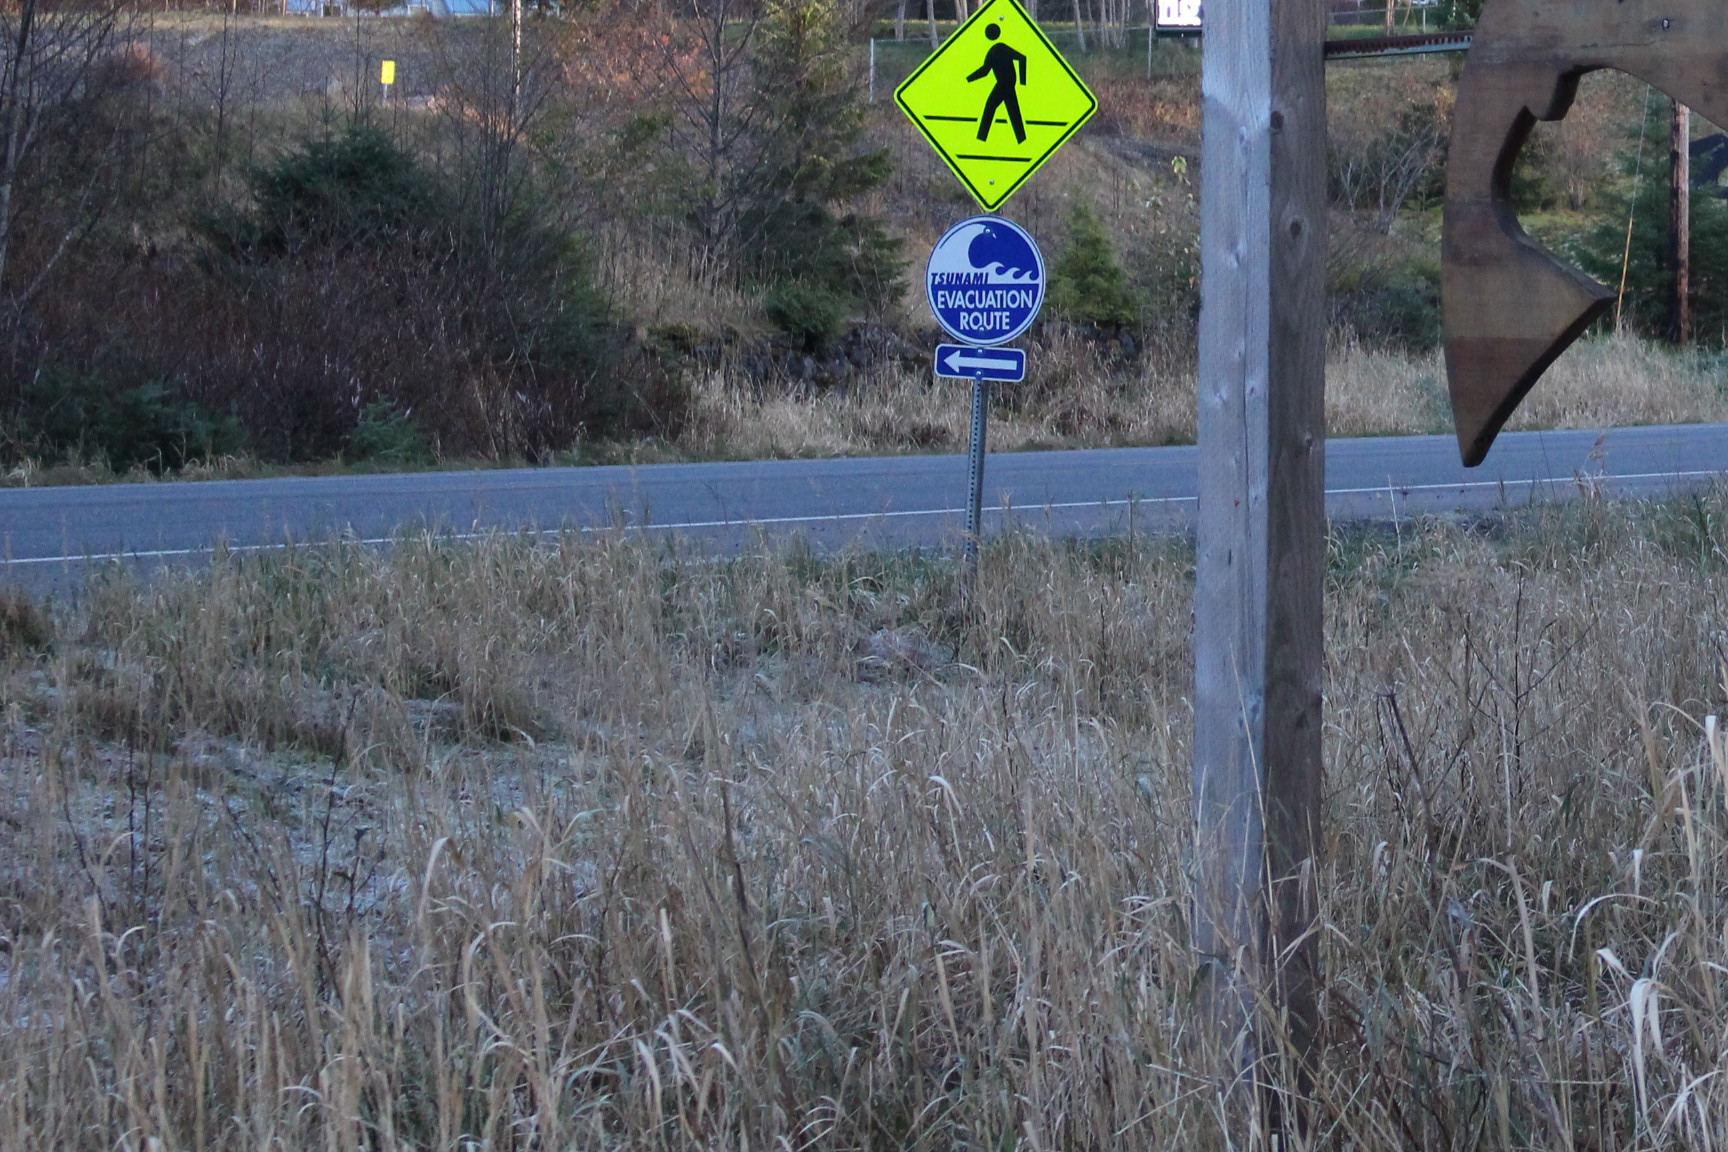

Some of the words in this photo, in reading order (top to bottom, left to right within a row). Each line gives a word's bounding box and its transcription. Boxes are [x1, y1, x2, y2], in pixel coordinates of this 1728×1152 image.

[931, 272, 989, 285] TSUNAMI
[937, 289, 1033, 309] EVACUATION
[960, 311, 1010, 330] ROUTE
